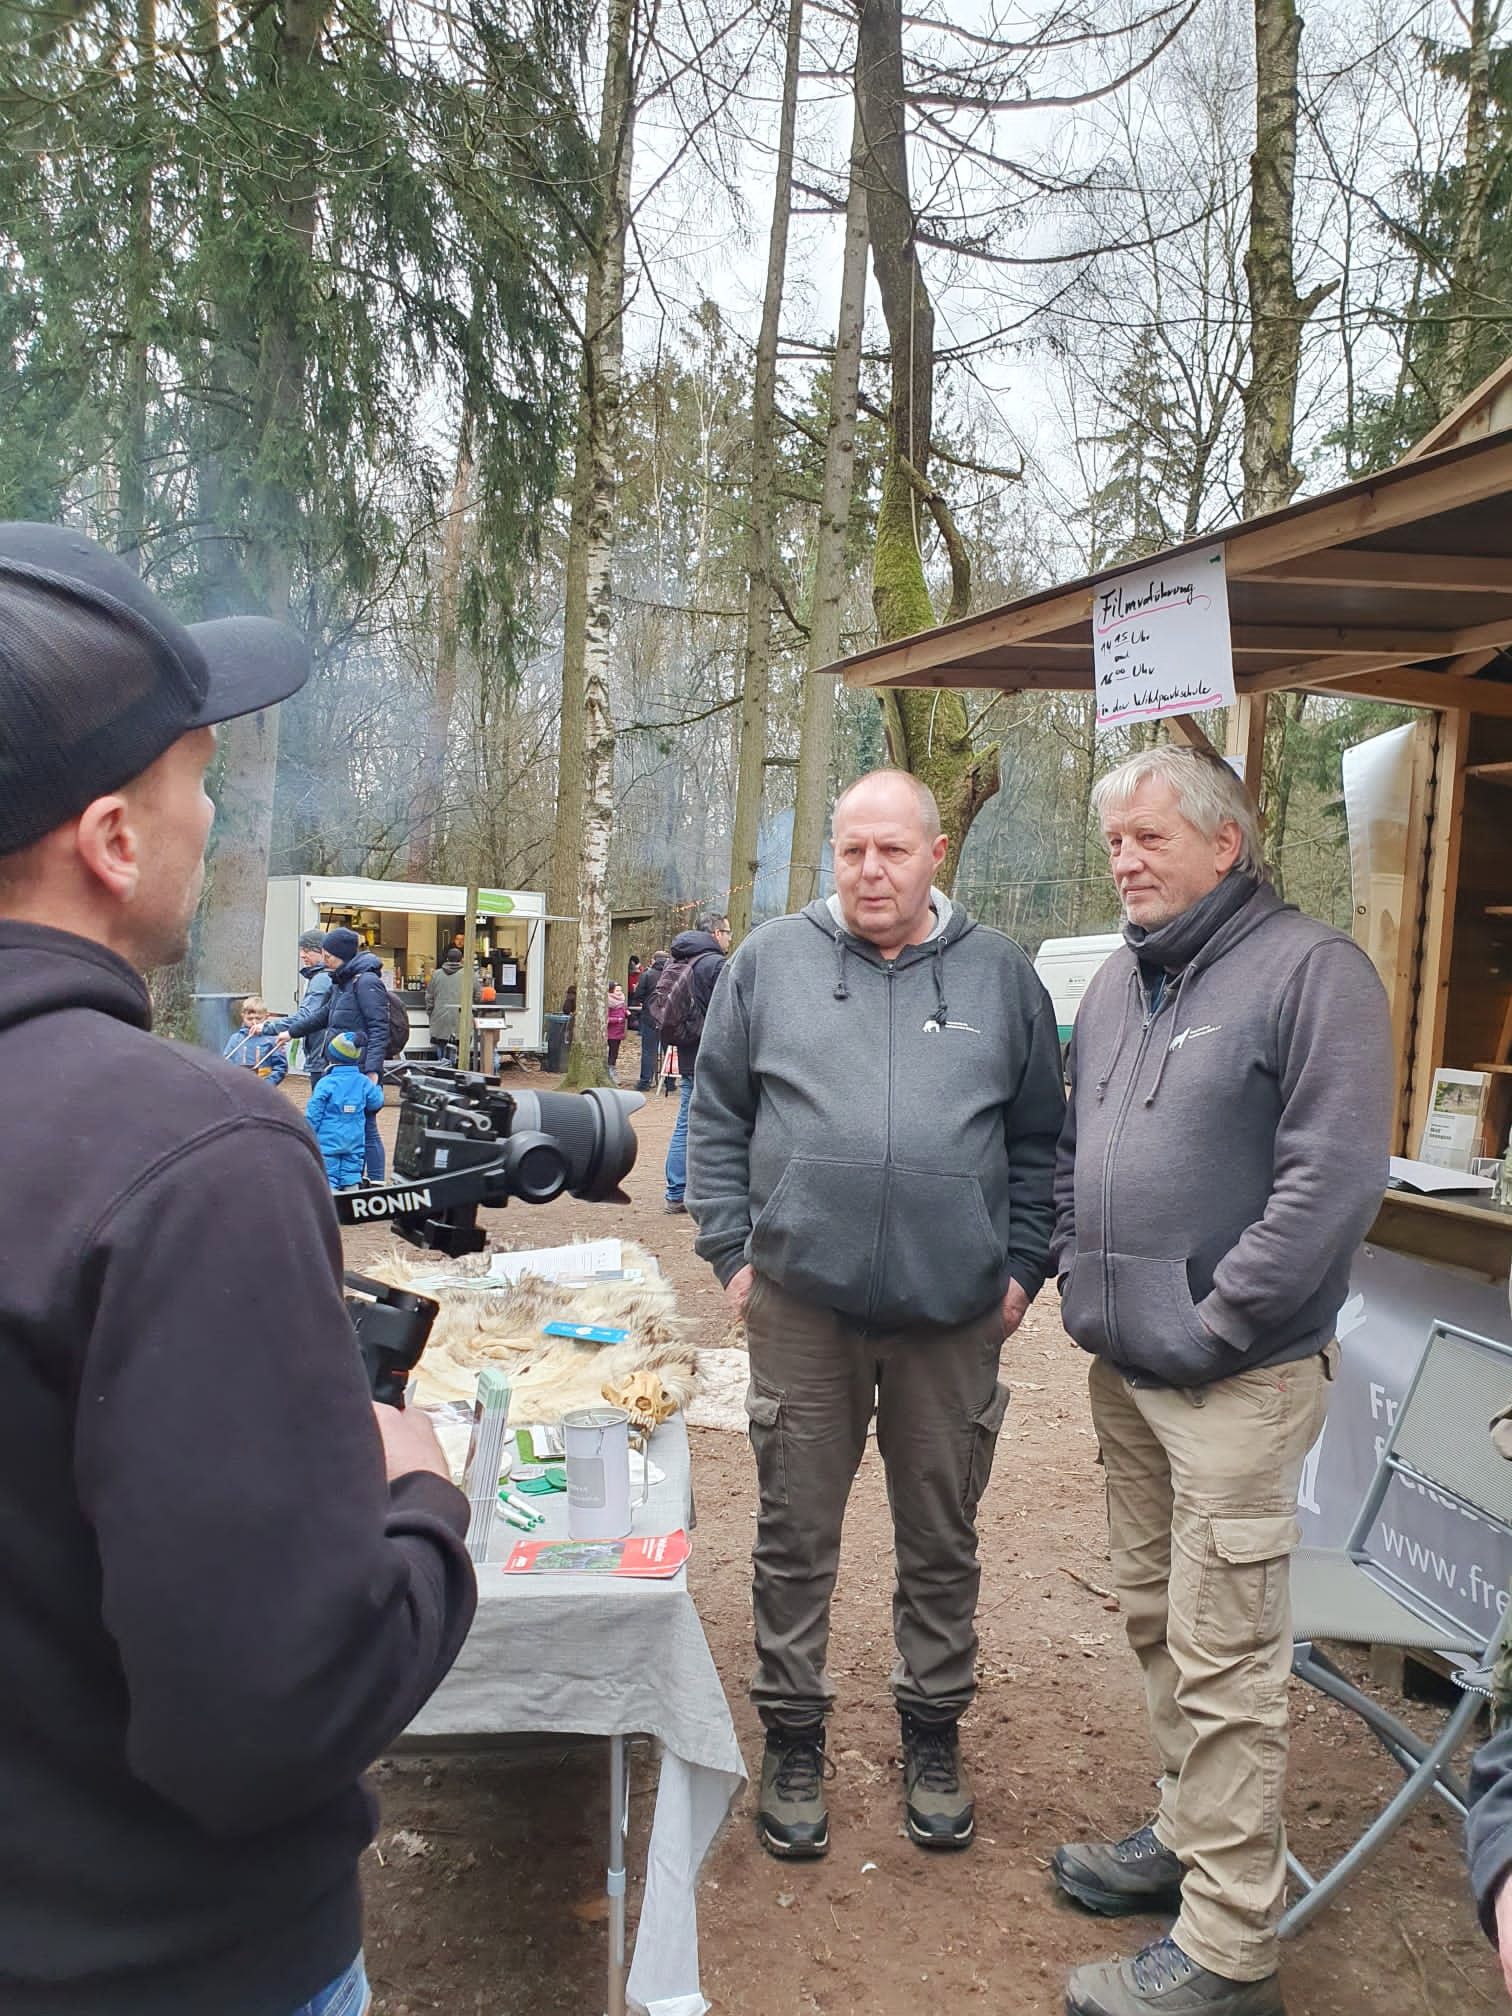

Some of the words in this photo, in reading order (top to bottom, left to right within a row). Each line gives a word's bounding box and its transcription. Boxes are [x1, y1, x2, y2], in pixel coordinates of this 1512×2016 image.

[1100, 581, 1194, 625] Filmvorführung
[1131, 630, 1150, 645] Uhr
[1132, 663, 1155, 677] Uhr
[1101, 703, 1109, 716] in
[1112, 696, 1129, 713] der
[1133, 680, 1212, 711] Wildparkschule
[352, 1189, 432, 1218] RONIN
[1369, 1381, 1399, 1427] Fr
[1382, 1521, 1511, 1617] www.fre
